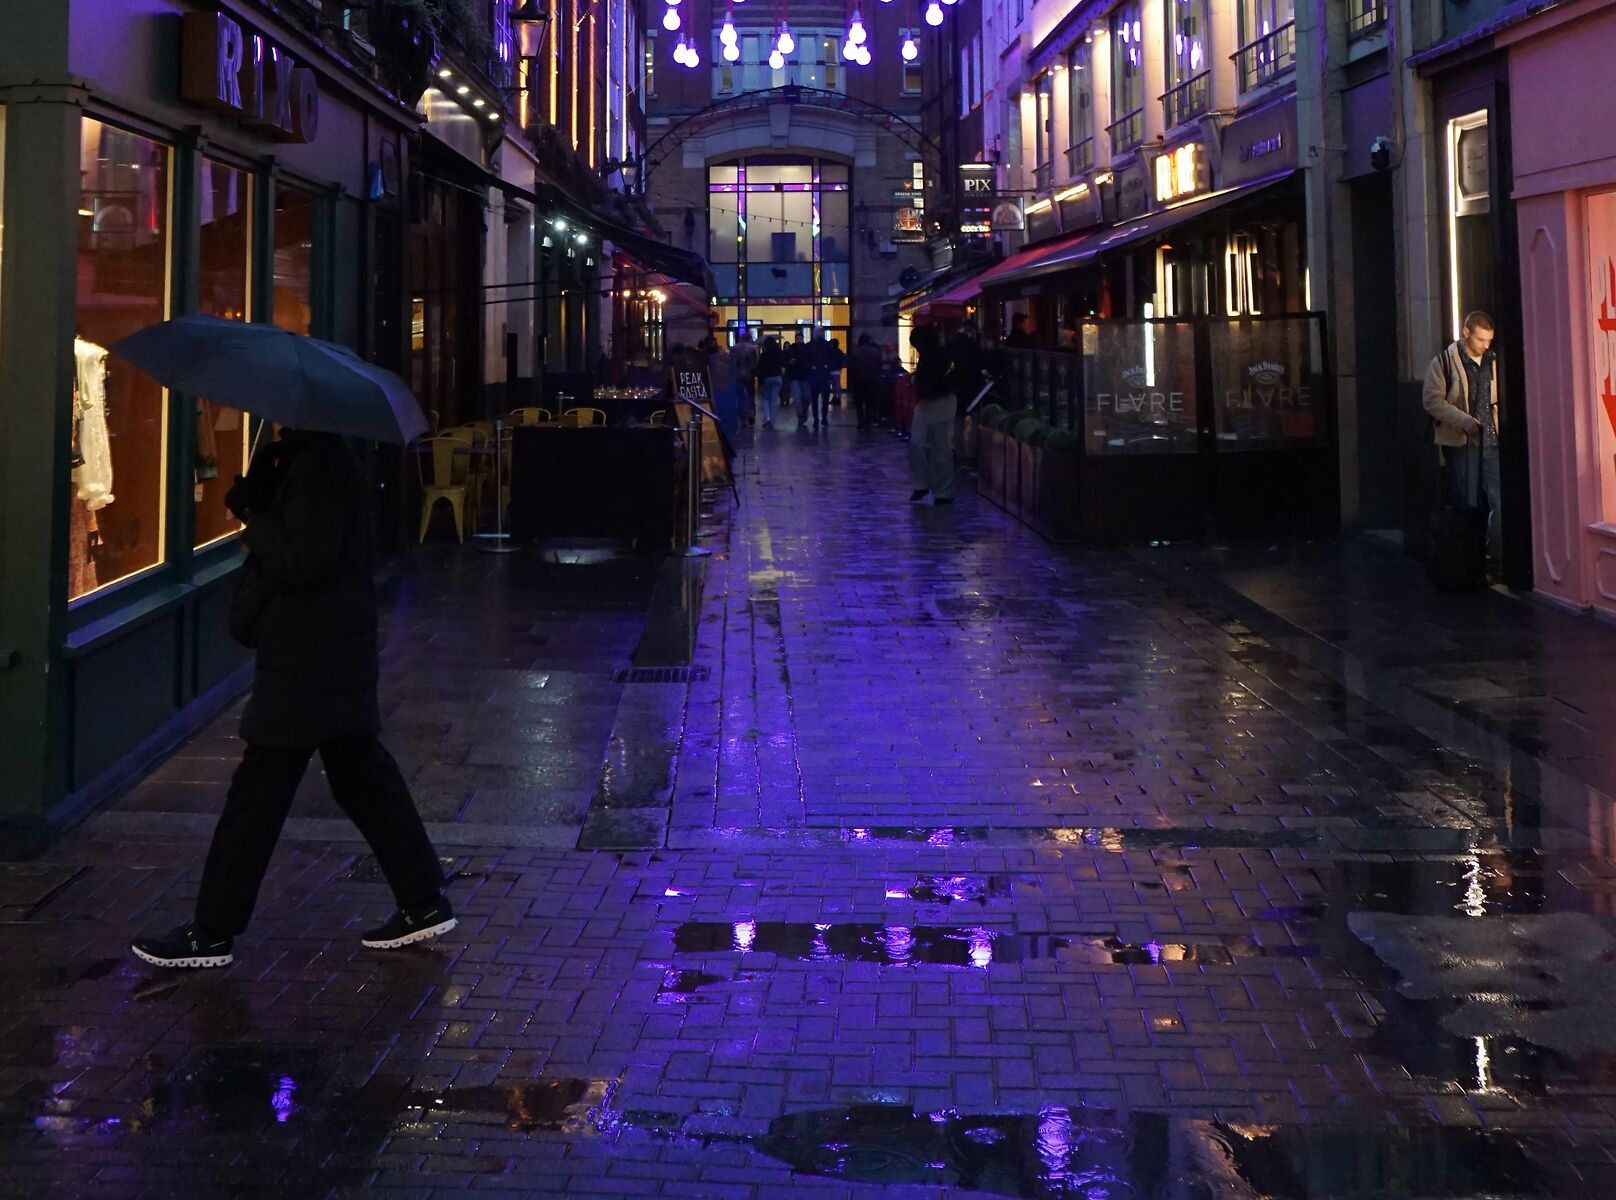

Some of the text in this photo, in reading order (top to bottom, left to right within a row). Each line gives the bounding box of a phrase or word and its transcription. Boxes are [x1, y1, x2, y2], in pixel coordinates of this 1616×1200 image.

[217, 11, 319, 143] RIXO
[964, 179, 992, 192] PIX
[680, 372, 704, 386] PEAK
[680, 385, 708, 400] PASTA
